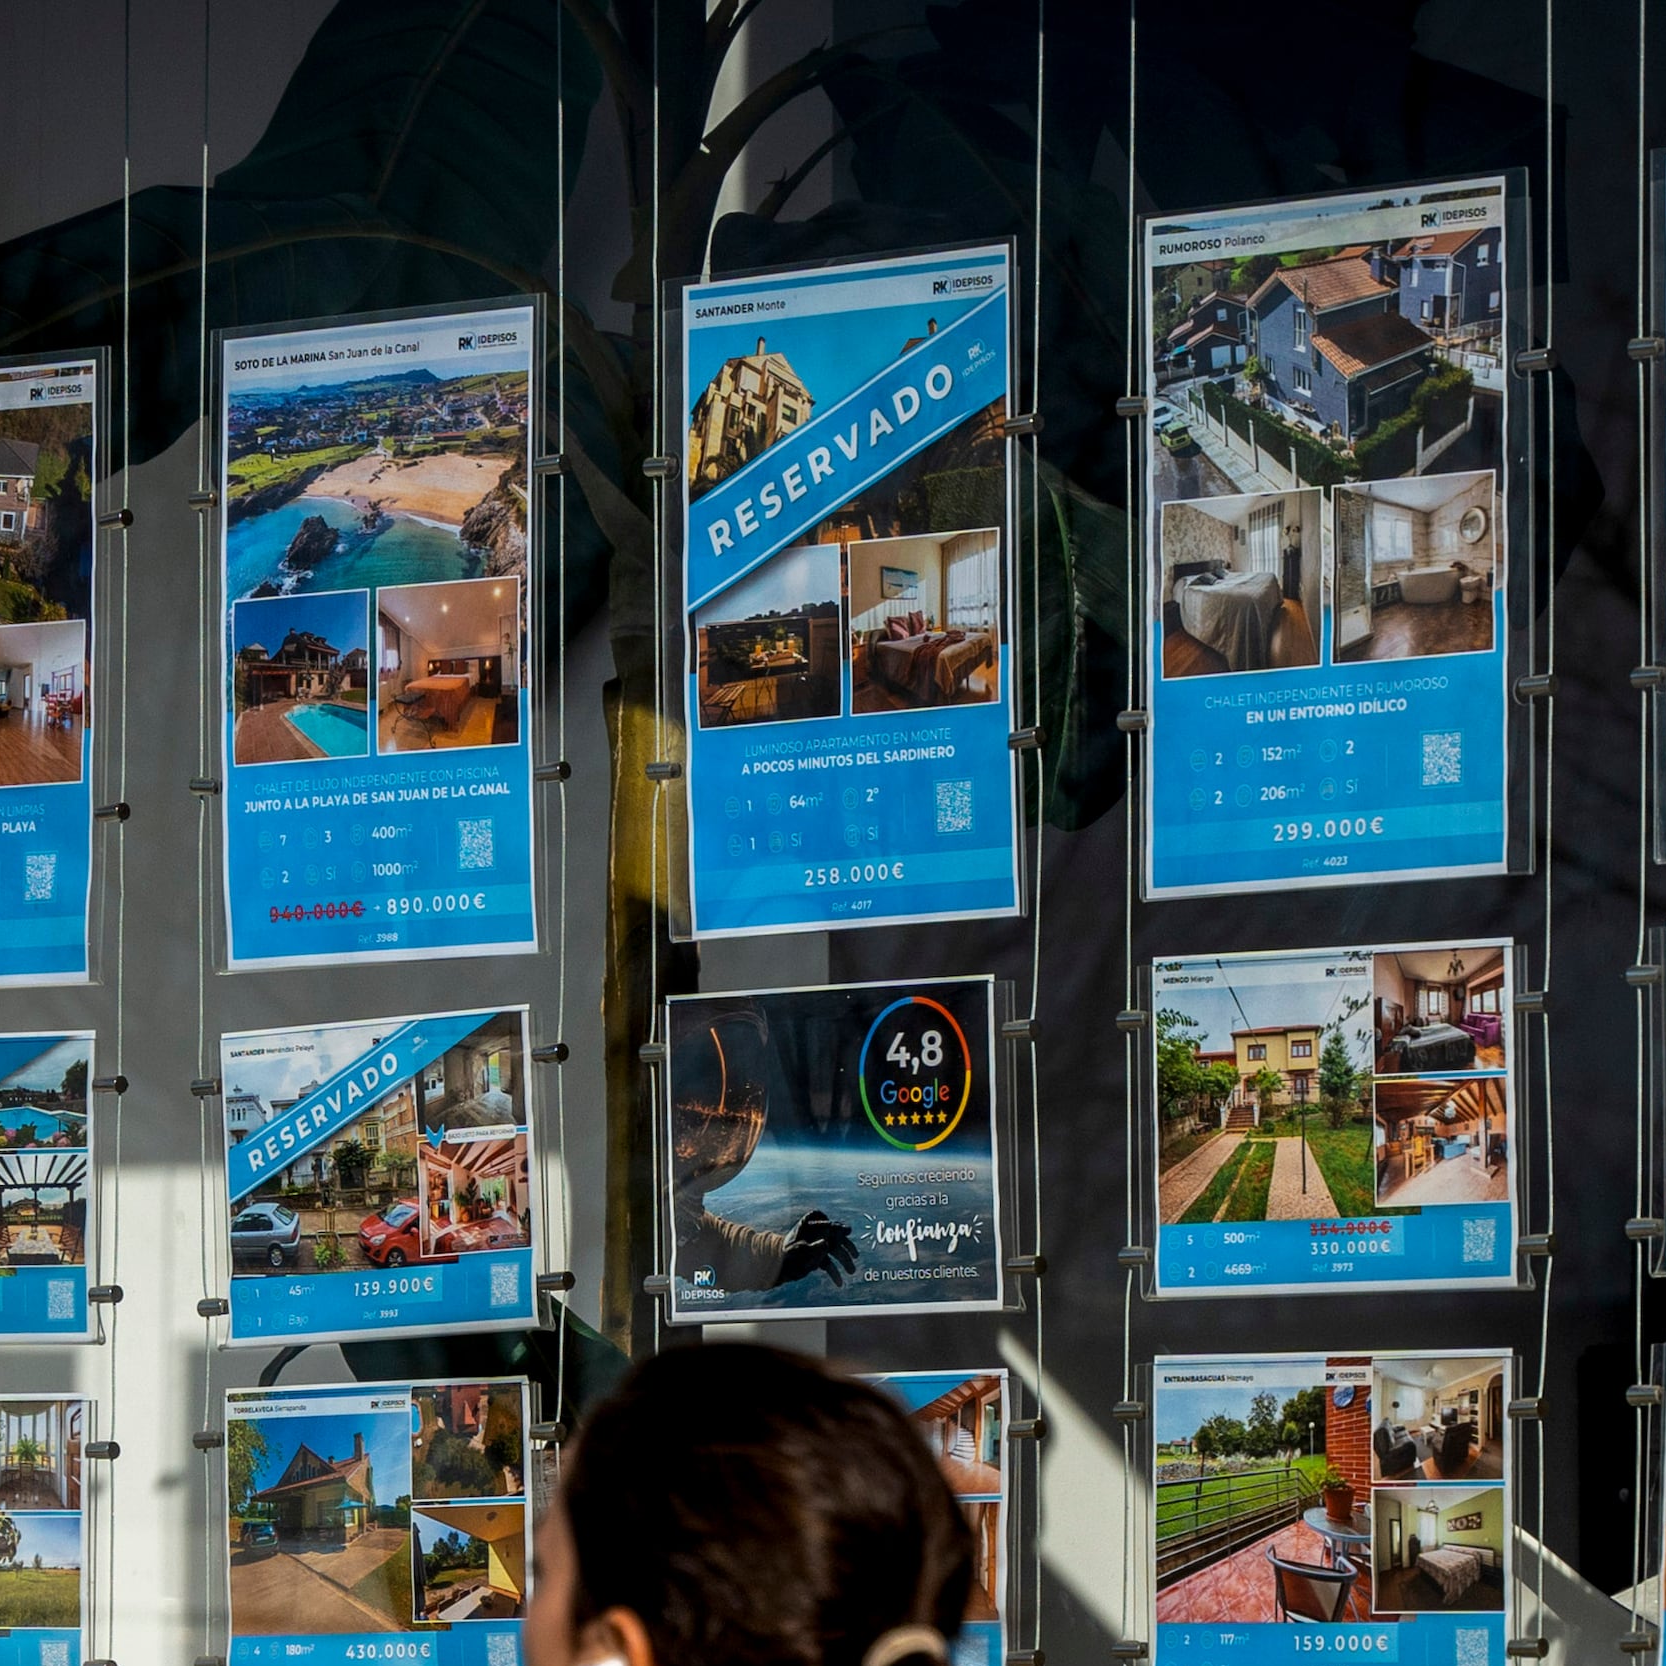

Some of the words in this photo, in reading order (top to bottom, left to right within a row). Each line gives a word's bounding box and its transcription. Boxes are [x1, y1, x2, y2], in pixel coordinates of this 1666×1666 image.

[1442, 207, 1487, 221] IDEPISOS
[1159, 239, 1222, 255] RUMOROSO
[1225, 234, 1265, 248] Polanco
[952, 275, 993, 288] IDEPISOS
[695, 303, 754, 319] SANTANDER
[756, 299, 786, 312] Monte
[478, 332, 517, 344] IDEPISOS
[235, 360, 259, 371] SOTO
[262, 358, 274, 368] DE
[277, 356, 288, 366] LA
[290, 352, 326, 365] MARINA
[329, 350, 344, 361] San
[347, 348, 368, 359] Juan
[371, 345, 382, 356] de
[384, 345, 392, 354] la
[395, 342, 419, 354] Canal
[708, 364, 953, 556] RESERVADO
[1246, 710, 1264, 724] EN
[1267, 709, 1285, 722] UN
[1289, 703, 1355, 720] ENTORNO
[1359, 698, 1407, 714] IDÍLICO
[742, 763, 750, 775] A
[754, 760, 794, 774] POCOS
[798, 755, 853, 770] MINUTOS
[857, 752, 880, 764] DEL
[884, 746, 955, 762] SARDINERO
[245, 800, 281, 813] JUNTO
[284, 799, 292, 809] A
[295, 798, 309, 809] LA
[313, 795, 350, 808] PLAYA
[353, 793, 368, 805] DE
[371, 791, 394, 803] SAN
[398, 789, 429, 802] JUAN
[433, 788, 448, 799] DE
[451, 786, 465, 797] LA
[470, 782, 510, 796] CANAL
[1273, 817, 1384, 842] 299.000€
[804, 862, 904, 886] 258.000€
[387, 893, 485, 915] 890.000€
[230, 1049, 265, 1058] SANTANDER
[886, 1030, 943, 1075] 4,8
[880, 1078, 950, 1108] Google
[247, 1053, 398, 1172] RESERVADO
[857, 1172, 915, 1187] Seguimos
[917, 1169, 975, 1183] creciendo
[886, 1195, 926, 1210] gracias
[929, 1197, 936, 1206] a
[938, 1193, 948, 1205] la
[876, 1219, 973, 1262] Confianza
[1310, 1240, 1391, 1256] 330.000€
[864, 1270, 879, 1281] de
[882, 1268, 932, 1280] nuestros
[354, 1277, 434, 1297] 139.900€
[681, 1288, 725, 1300] IDEPISOS
[346, 1643, 431, 1659] 430.000€
[1294, 1635, 1388, 1651] 159.000€
